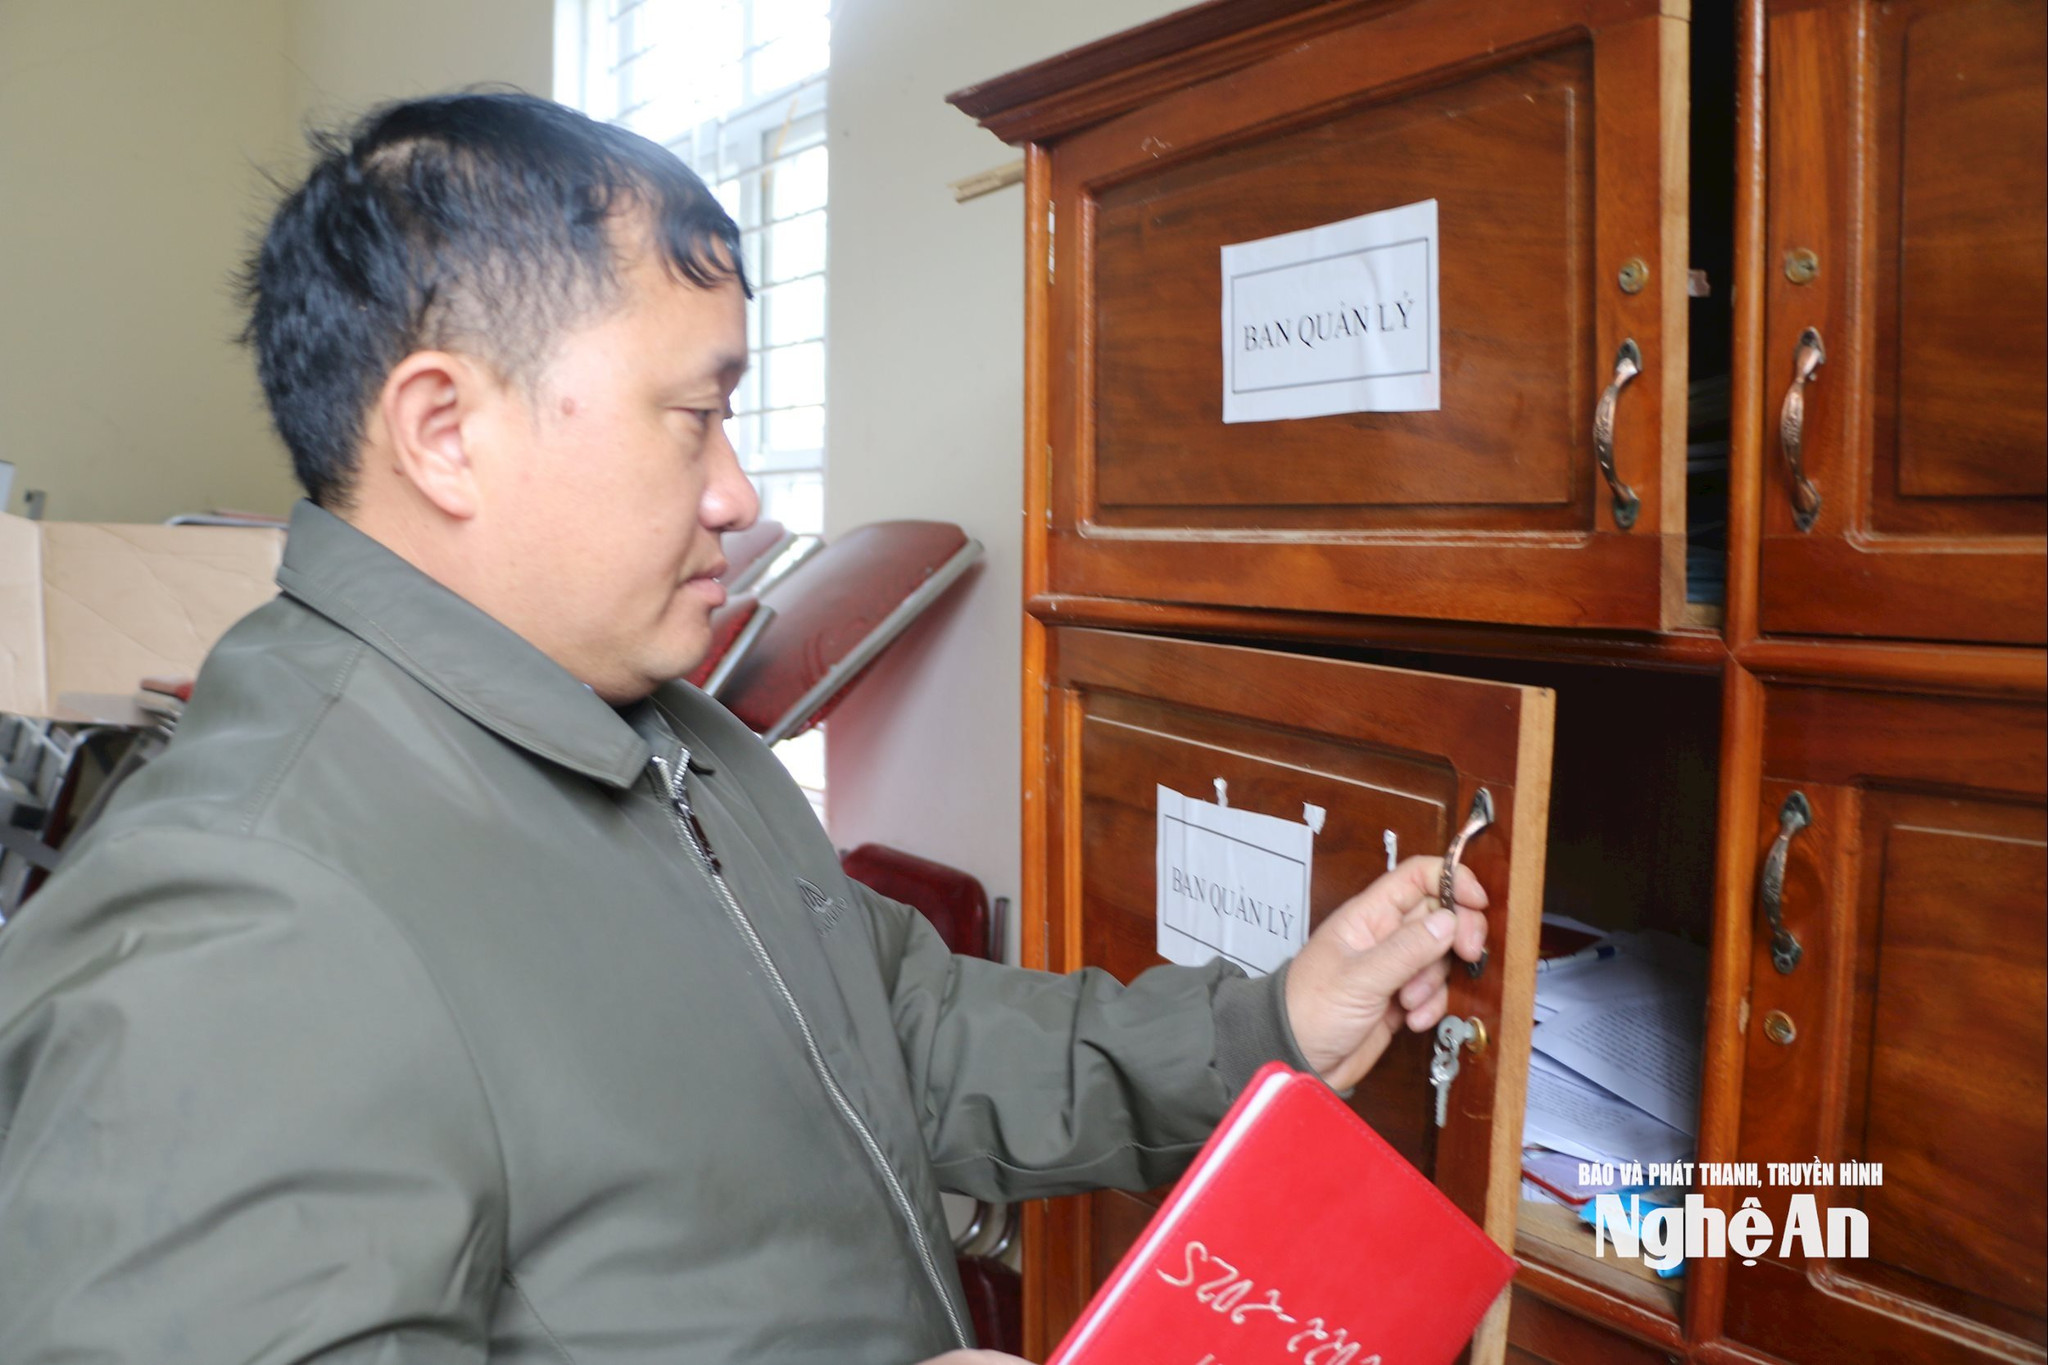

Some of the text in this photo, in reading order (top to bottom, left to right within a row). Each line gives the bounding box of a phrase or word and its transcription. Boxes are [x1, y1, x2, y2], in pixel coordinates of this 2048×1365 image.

[1243, 319, 1291, 351] BAN
[1297, 299, 1371, 349] QUẢN
[1172, 866, 1205, 902] BAN
[1209, 882, 1262, 928] QUẢN
